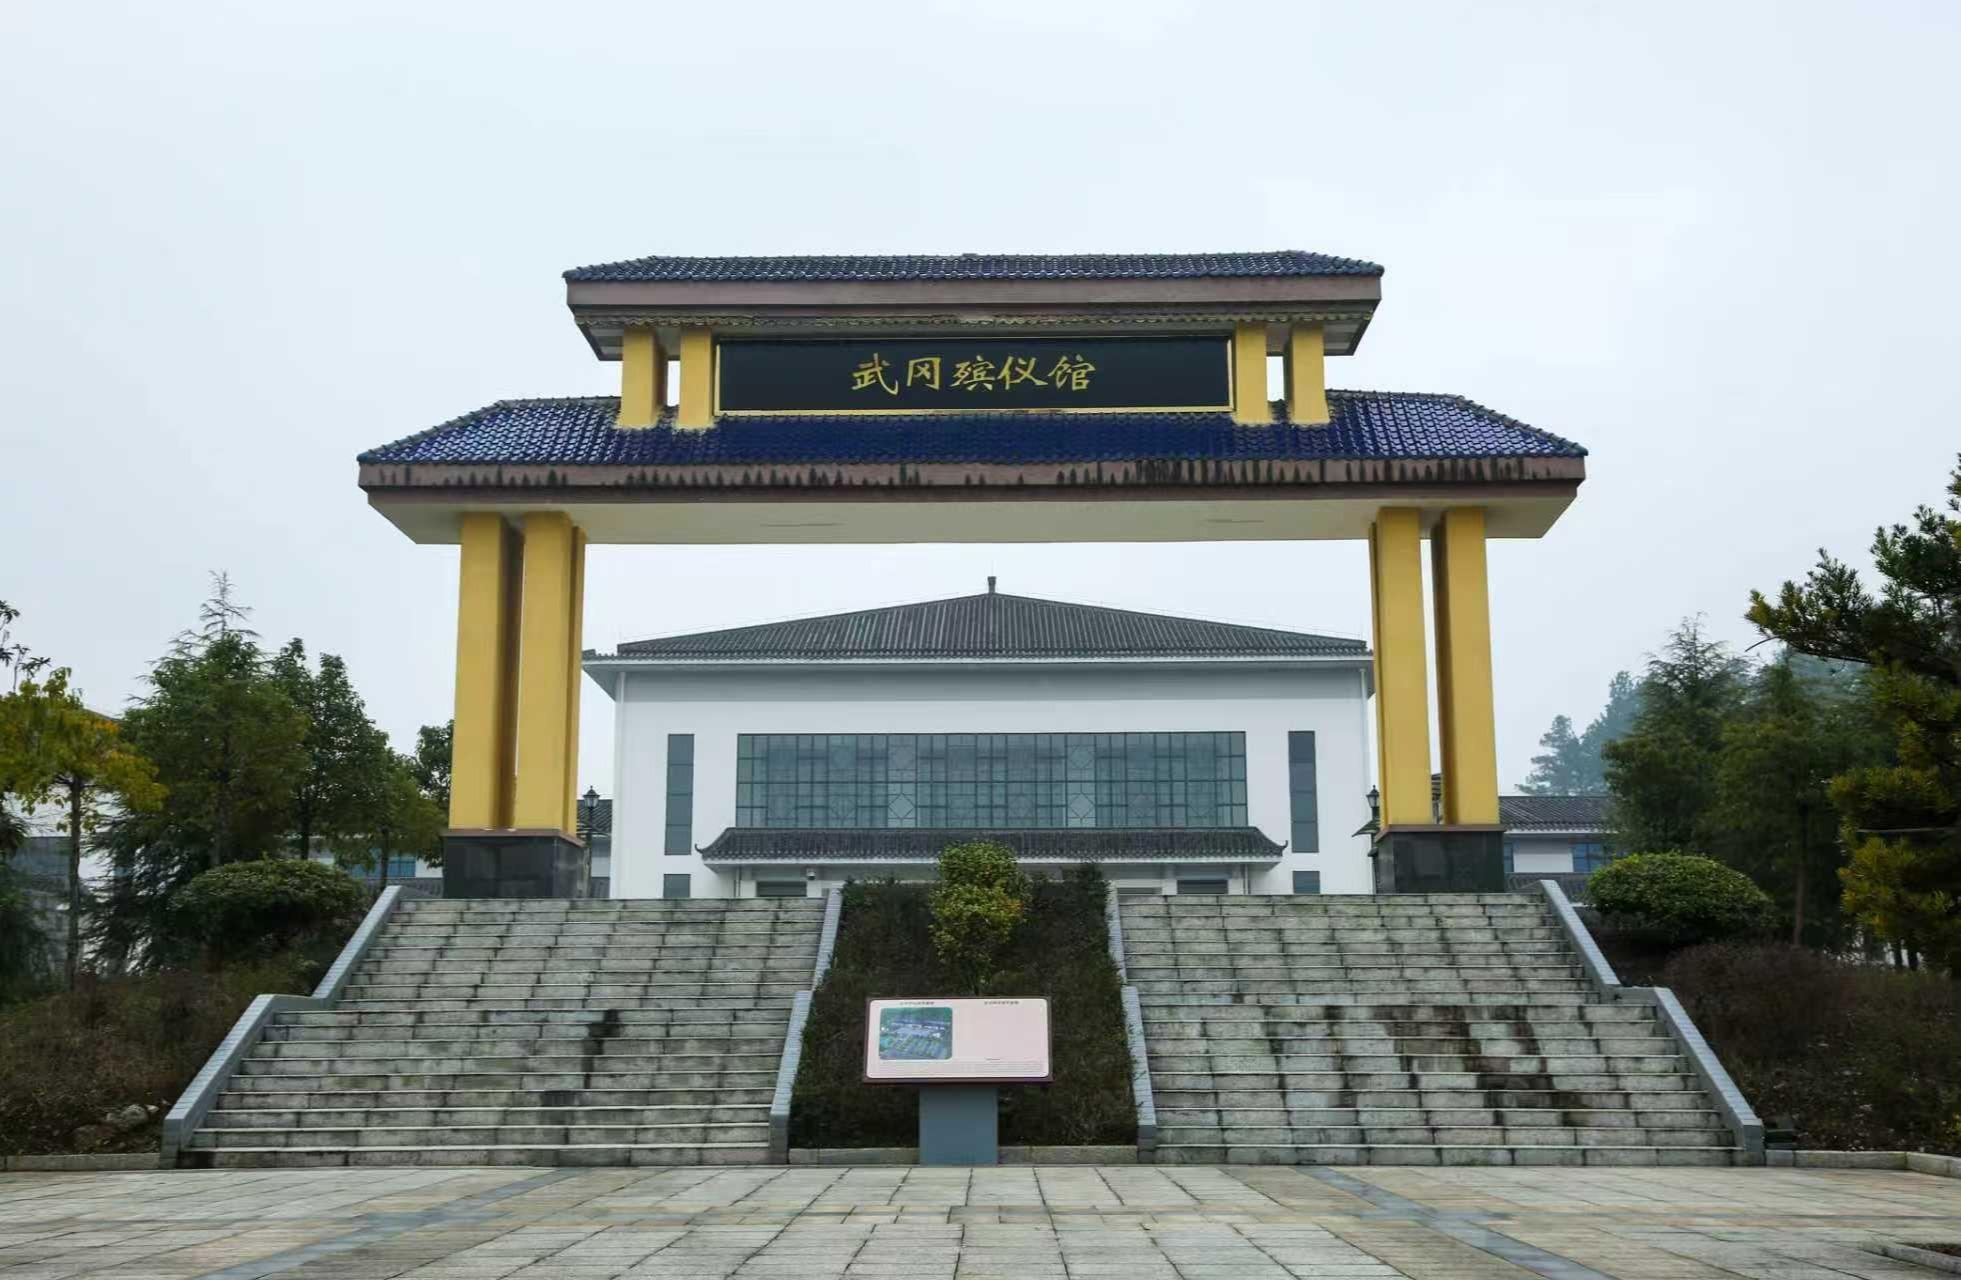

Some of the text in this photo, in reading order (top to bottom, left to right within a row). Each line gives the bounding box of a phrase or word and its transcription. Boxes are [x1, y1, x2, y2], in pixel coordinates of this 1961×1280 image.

[851, 353, 1096, 395] 武冈殡仪馆
